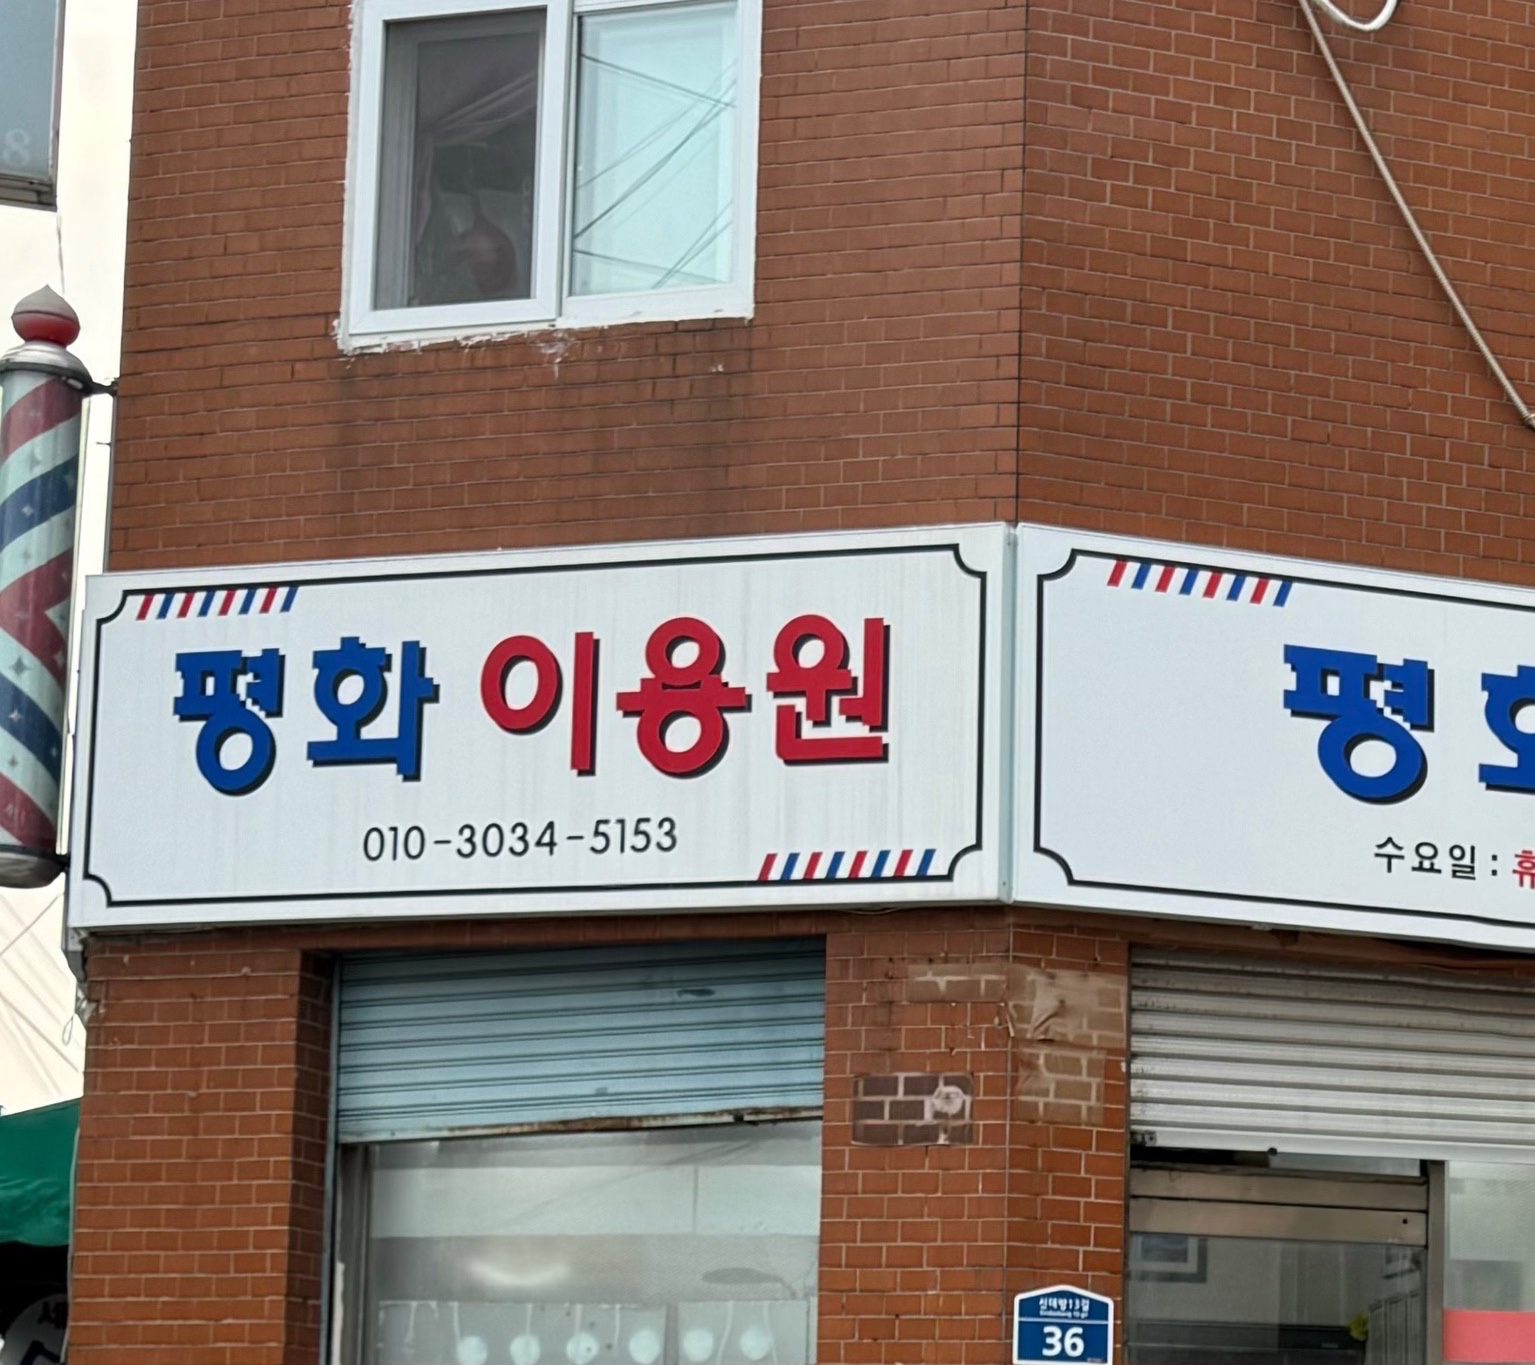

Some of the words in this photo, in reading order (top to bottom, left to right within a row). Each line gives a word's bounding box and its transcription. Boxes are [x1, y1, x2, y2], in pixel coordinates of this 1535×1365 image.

[174, 638, 438, 793] 평화
[481, 614, 888, 777] 이용원
[362, 816, 679, 862] 010-3034-5153
[1041, 1324, 1085, 1358] 36
